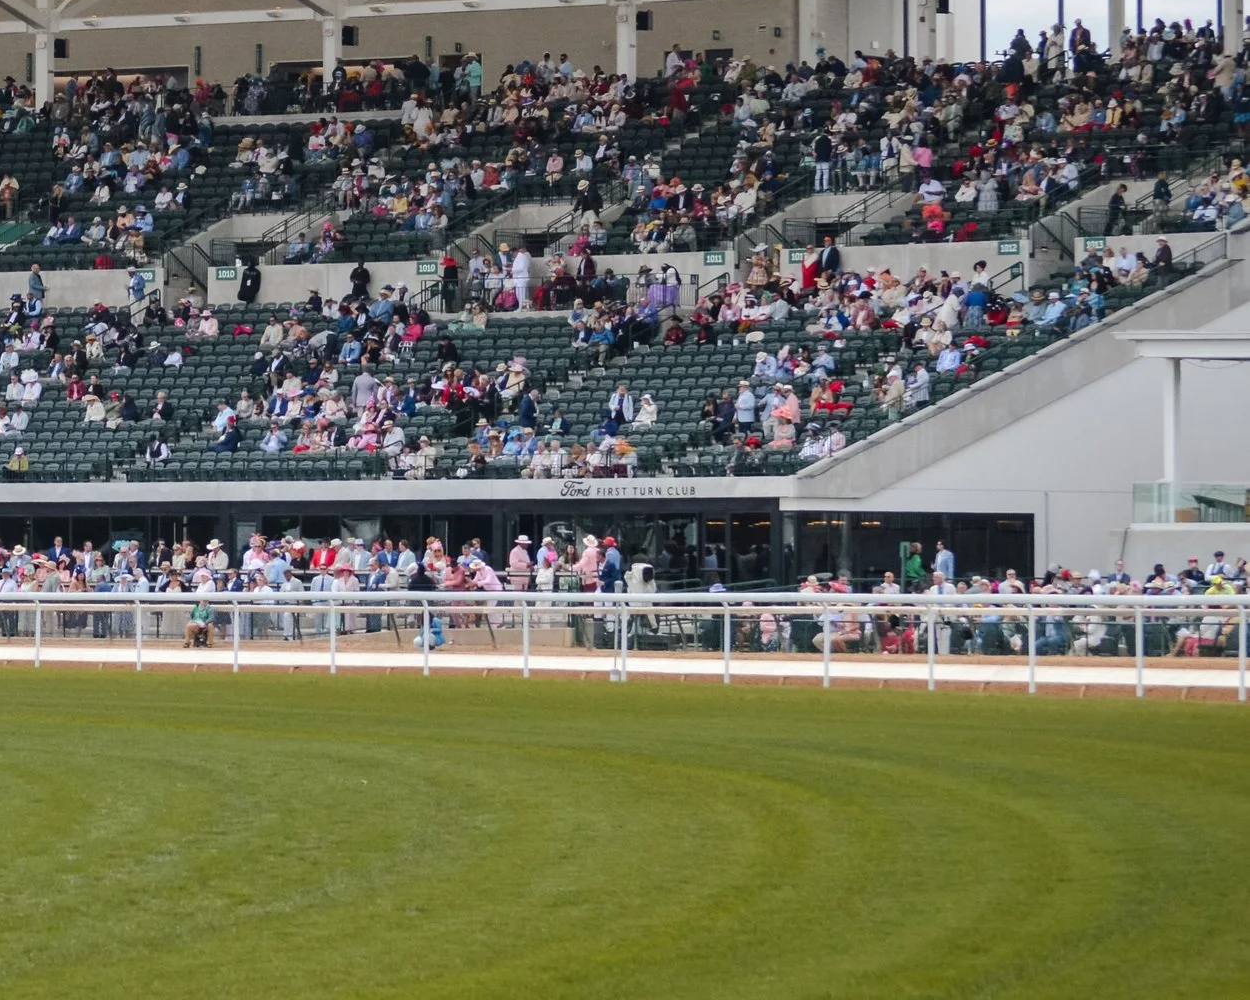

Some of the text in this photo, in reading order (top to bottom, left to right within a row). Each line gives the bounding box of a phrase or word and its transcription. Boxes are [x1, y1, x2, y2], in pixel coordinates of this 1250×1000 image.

[706, 254, 722, 263] 1011
[419, 264, 436, 273] 1010
[218, 270, 235, 278] 1010
[560, 480, 696, 497] Ford FIRST TURN CLUB
